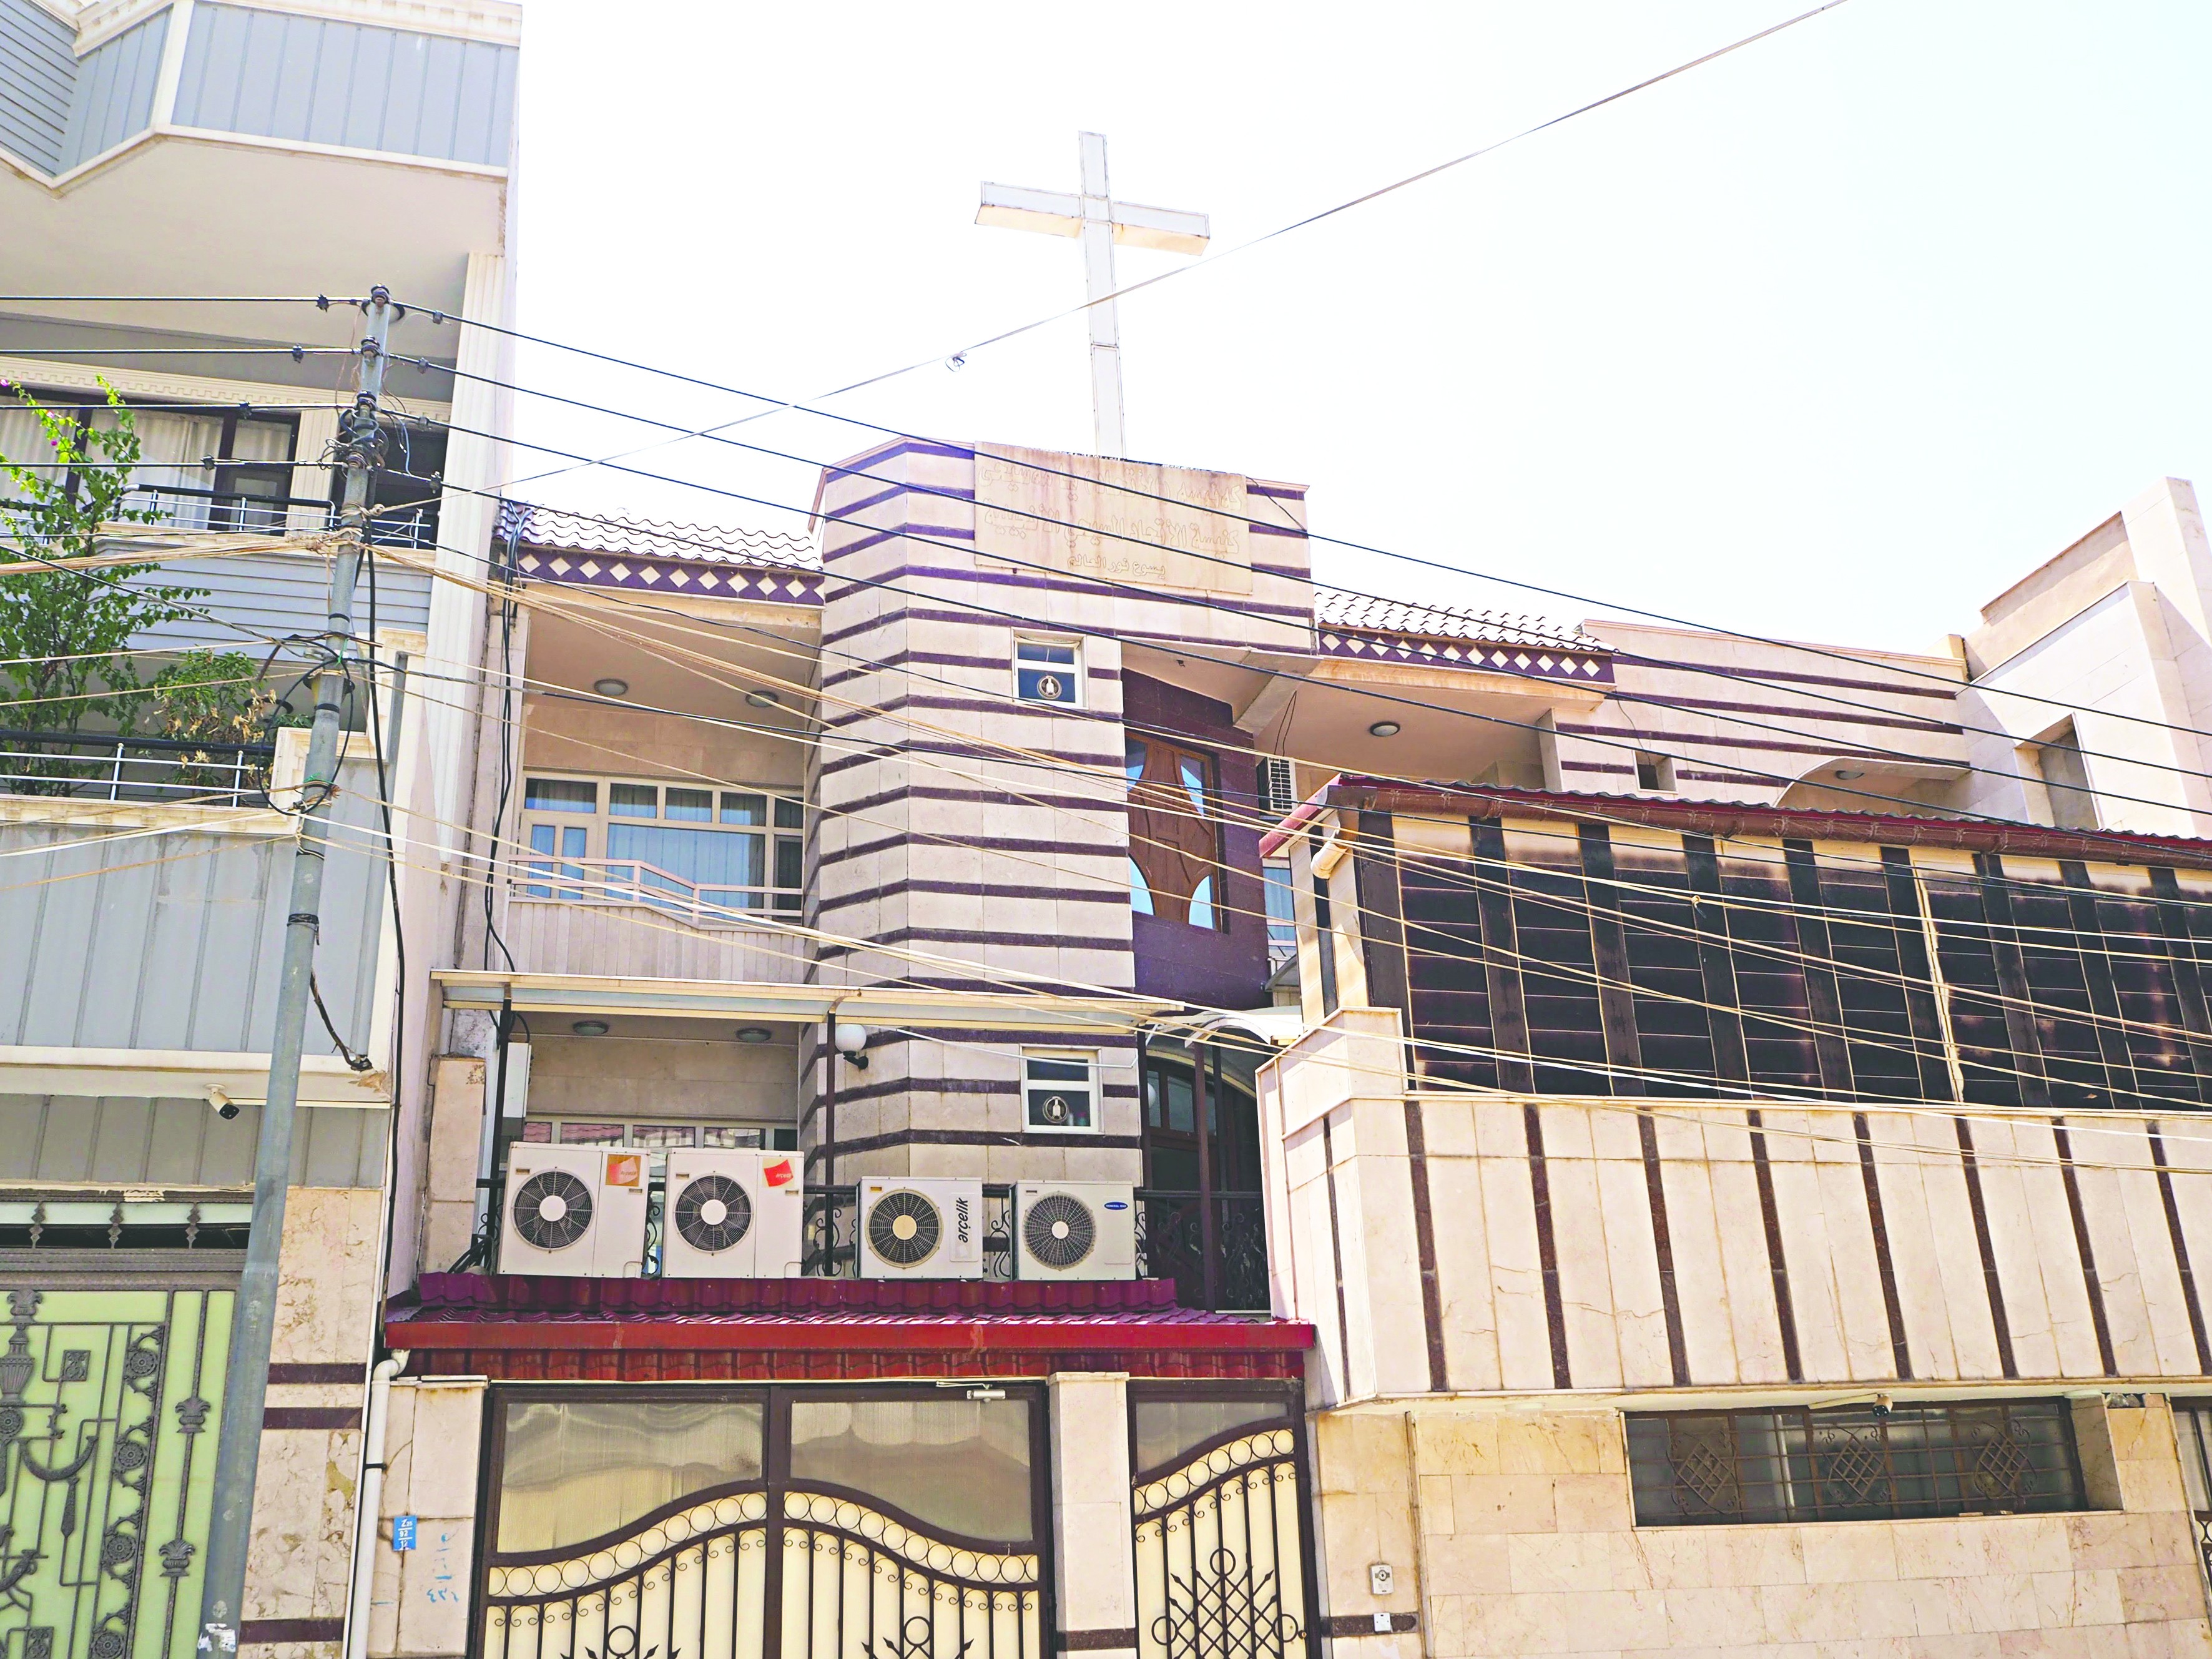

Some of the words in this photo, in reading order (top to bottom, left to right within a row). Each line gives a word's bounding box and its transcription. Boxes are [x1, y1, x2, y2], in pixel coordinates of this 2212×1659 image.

[1189, 523, 1239, 561] كنيسة
[1067, 553, 1107, 568] العالم
[1108, 558, 1130, 574] نور
[1132, 561, 1166, 580] يسوع
[956, 1197, 971, 1243] arçelik
